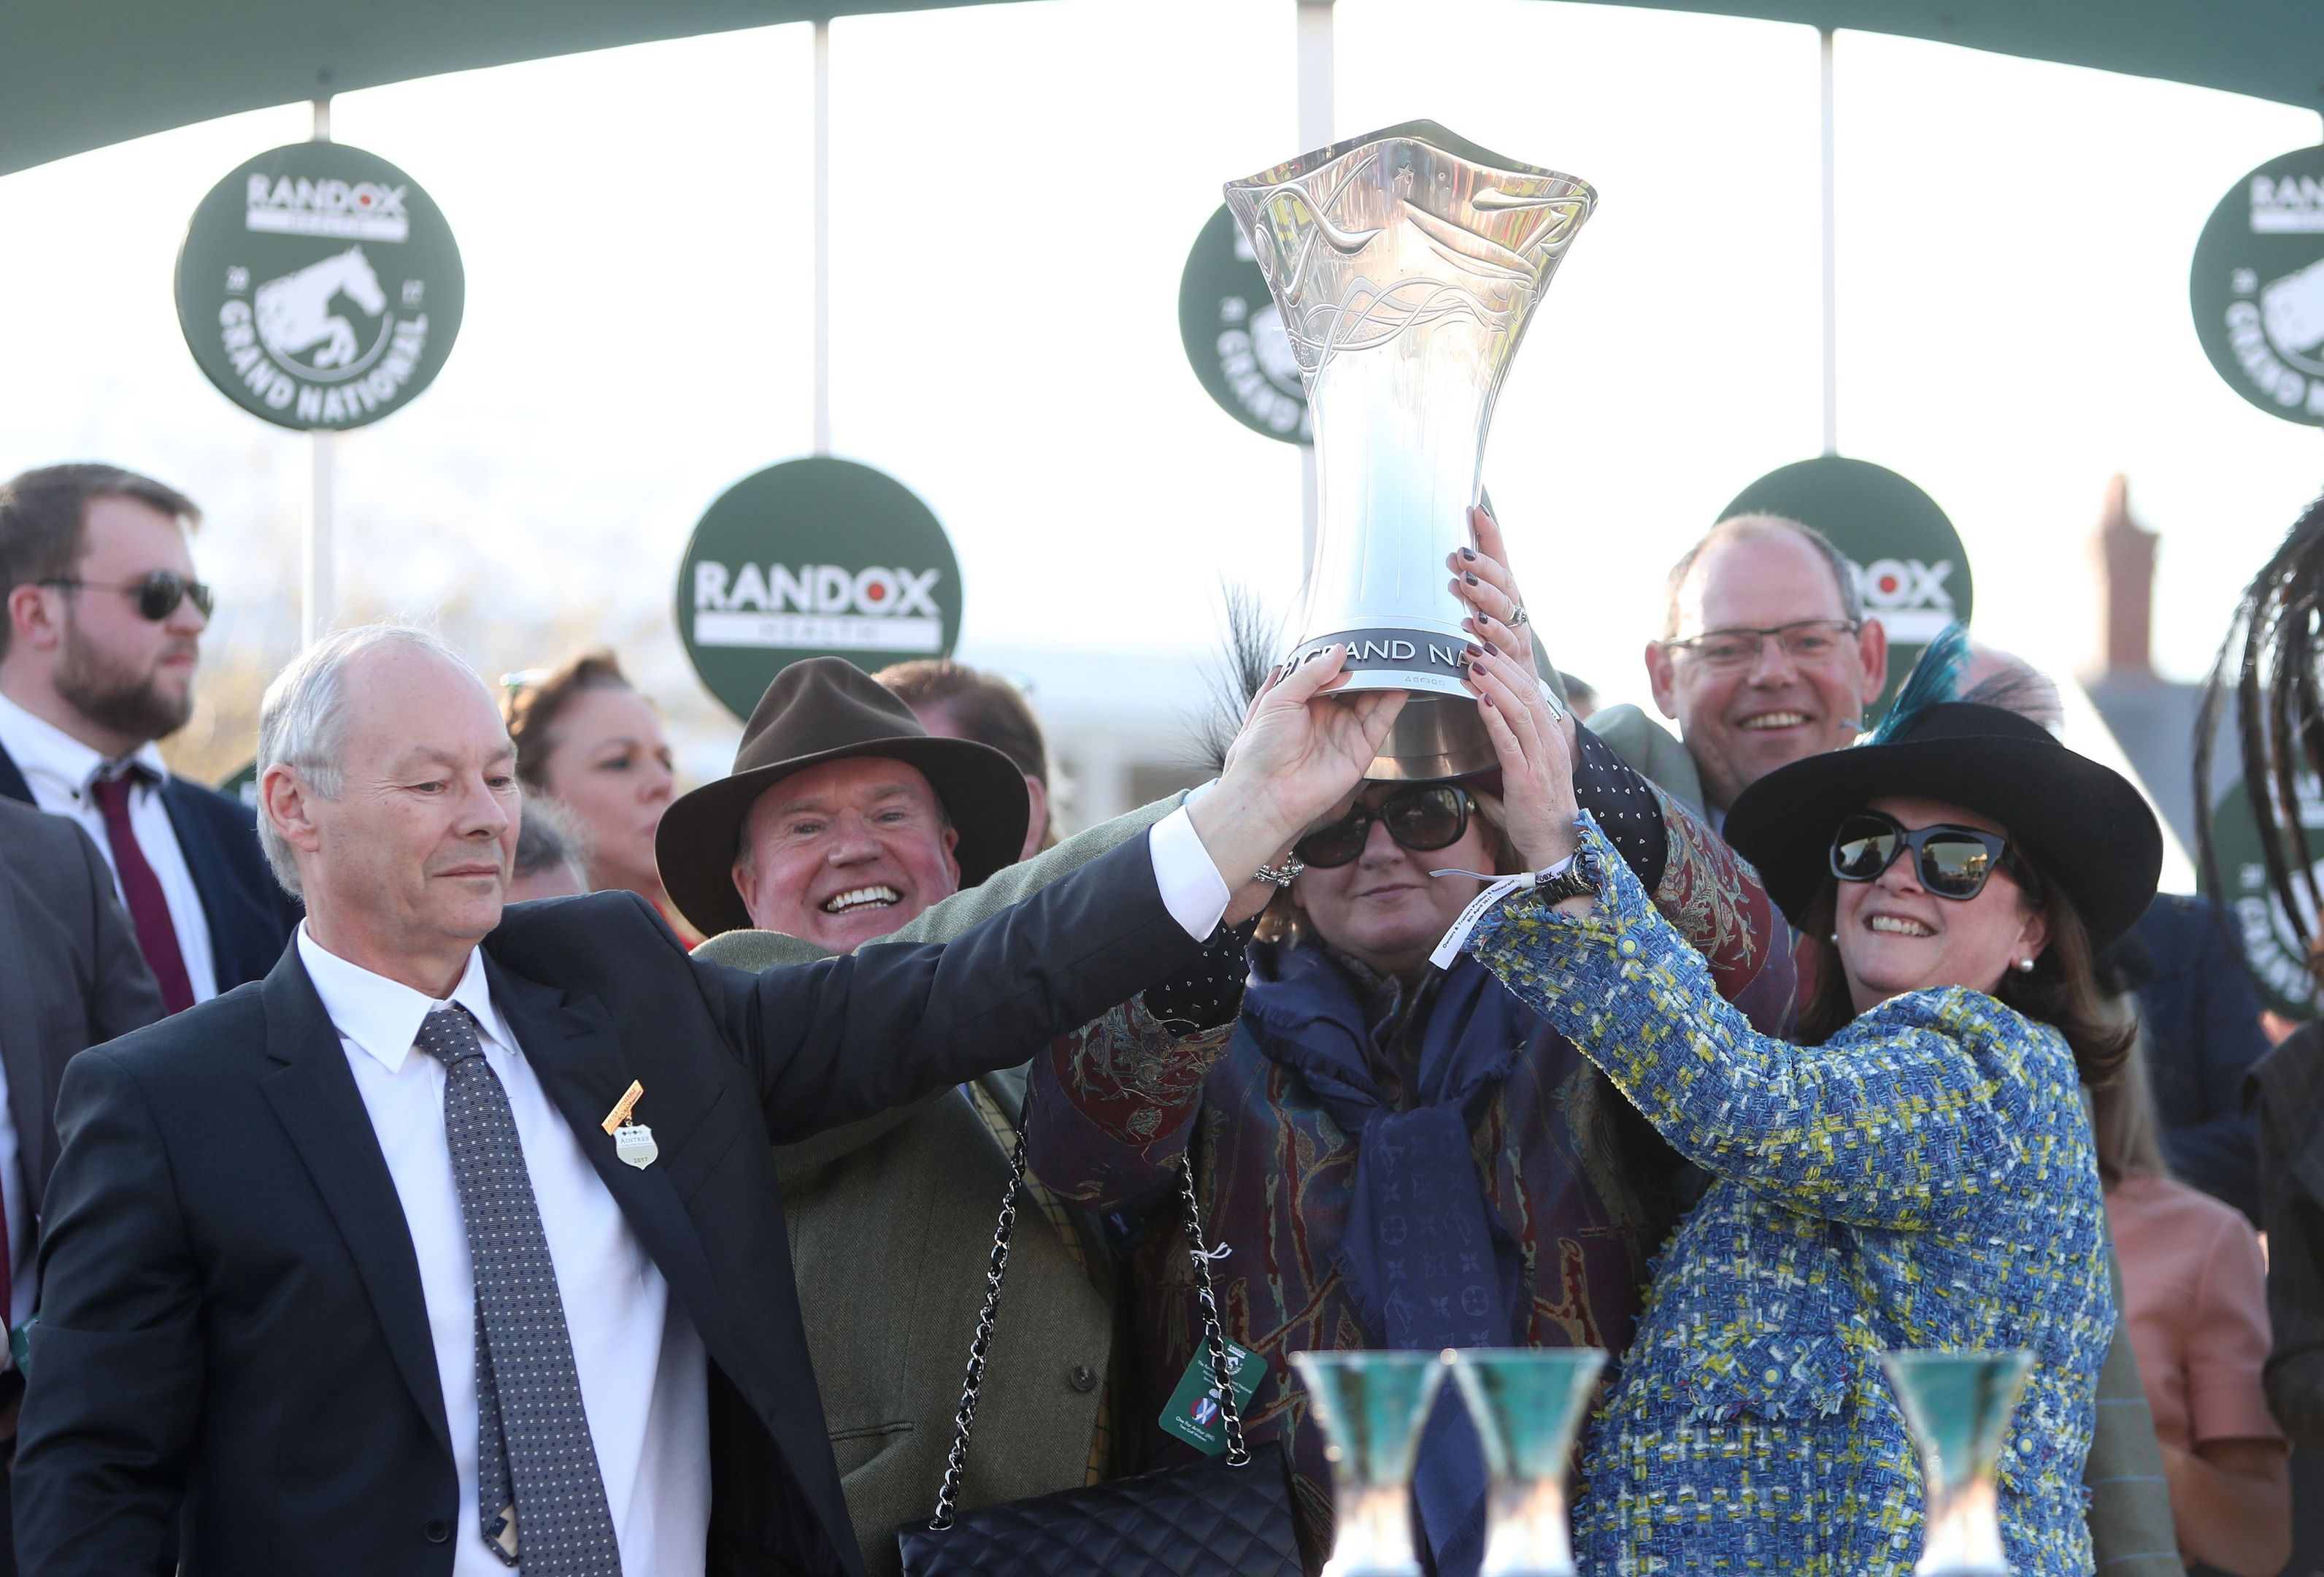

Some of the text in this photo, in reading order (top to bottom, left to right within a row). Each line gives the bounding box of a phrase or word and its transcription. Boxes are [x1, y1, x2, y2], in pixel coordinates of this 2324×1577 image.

[247, 173, 408, 217] RANDOX
[220, 299, 428, 423] GRAND NATIONAL
[1216, 329, 1300, 434] GRAND
[2225, 300, 2306, 407] GRAND
[694, 560, 942, 616] RANDOX
[1442, 931, 1455, 948] Owners
[1458, 908, 1473, 926] Trainers
[1491, 879, 1515, 893] Restaurant
[620, 1136, 650, 1144] AINTREE
